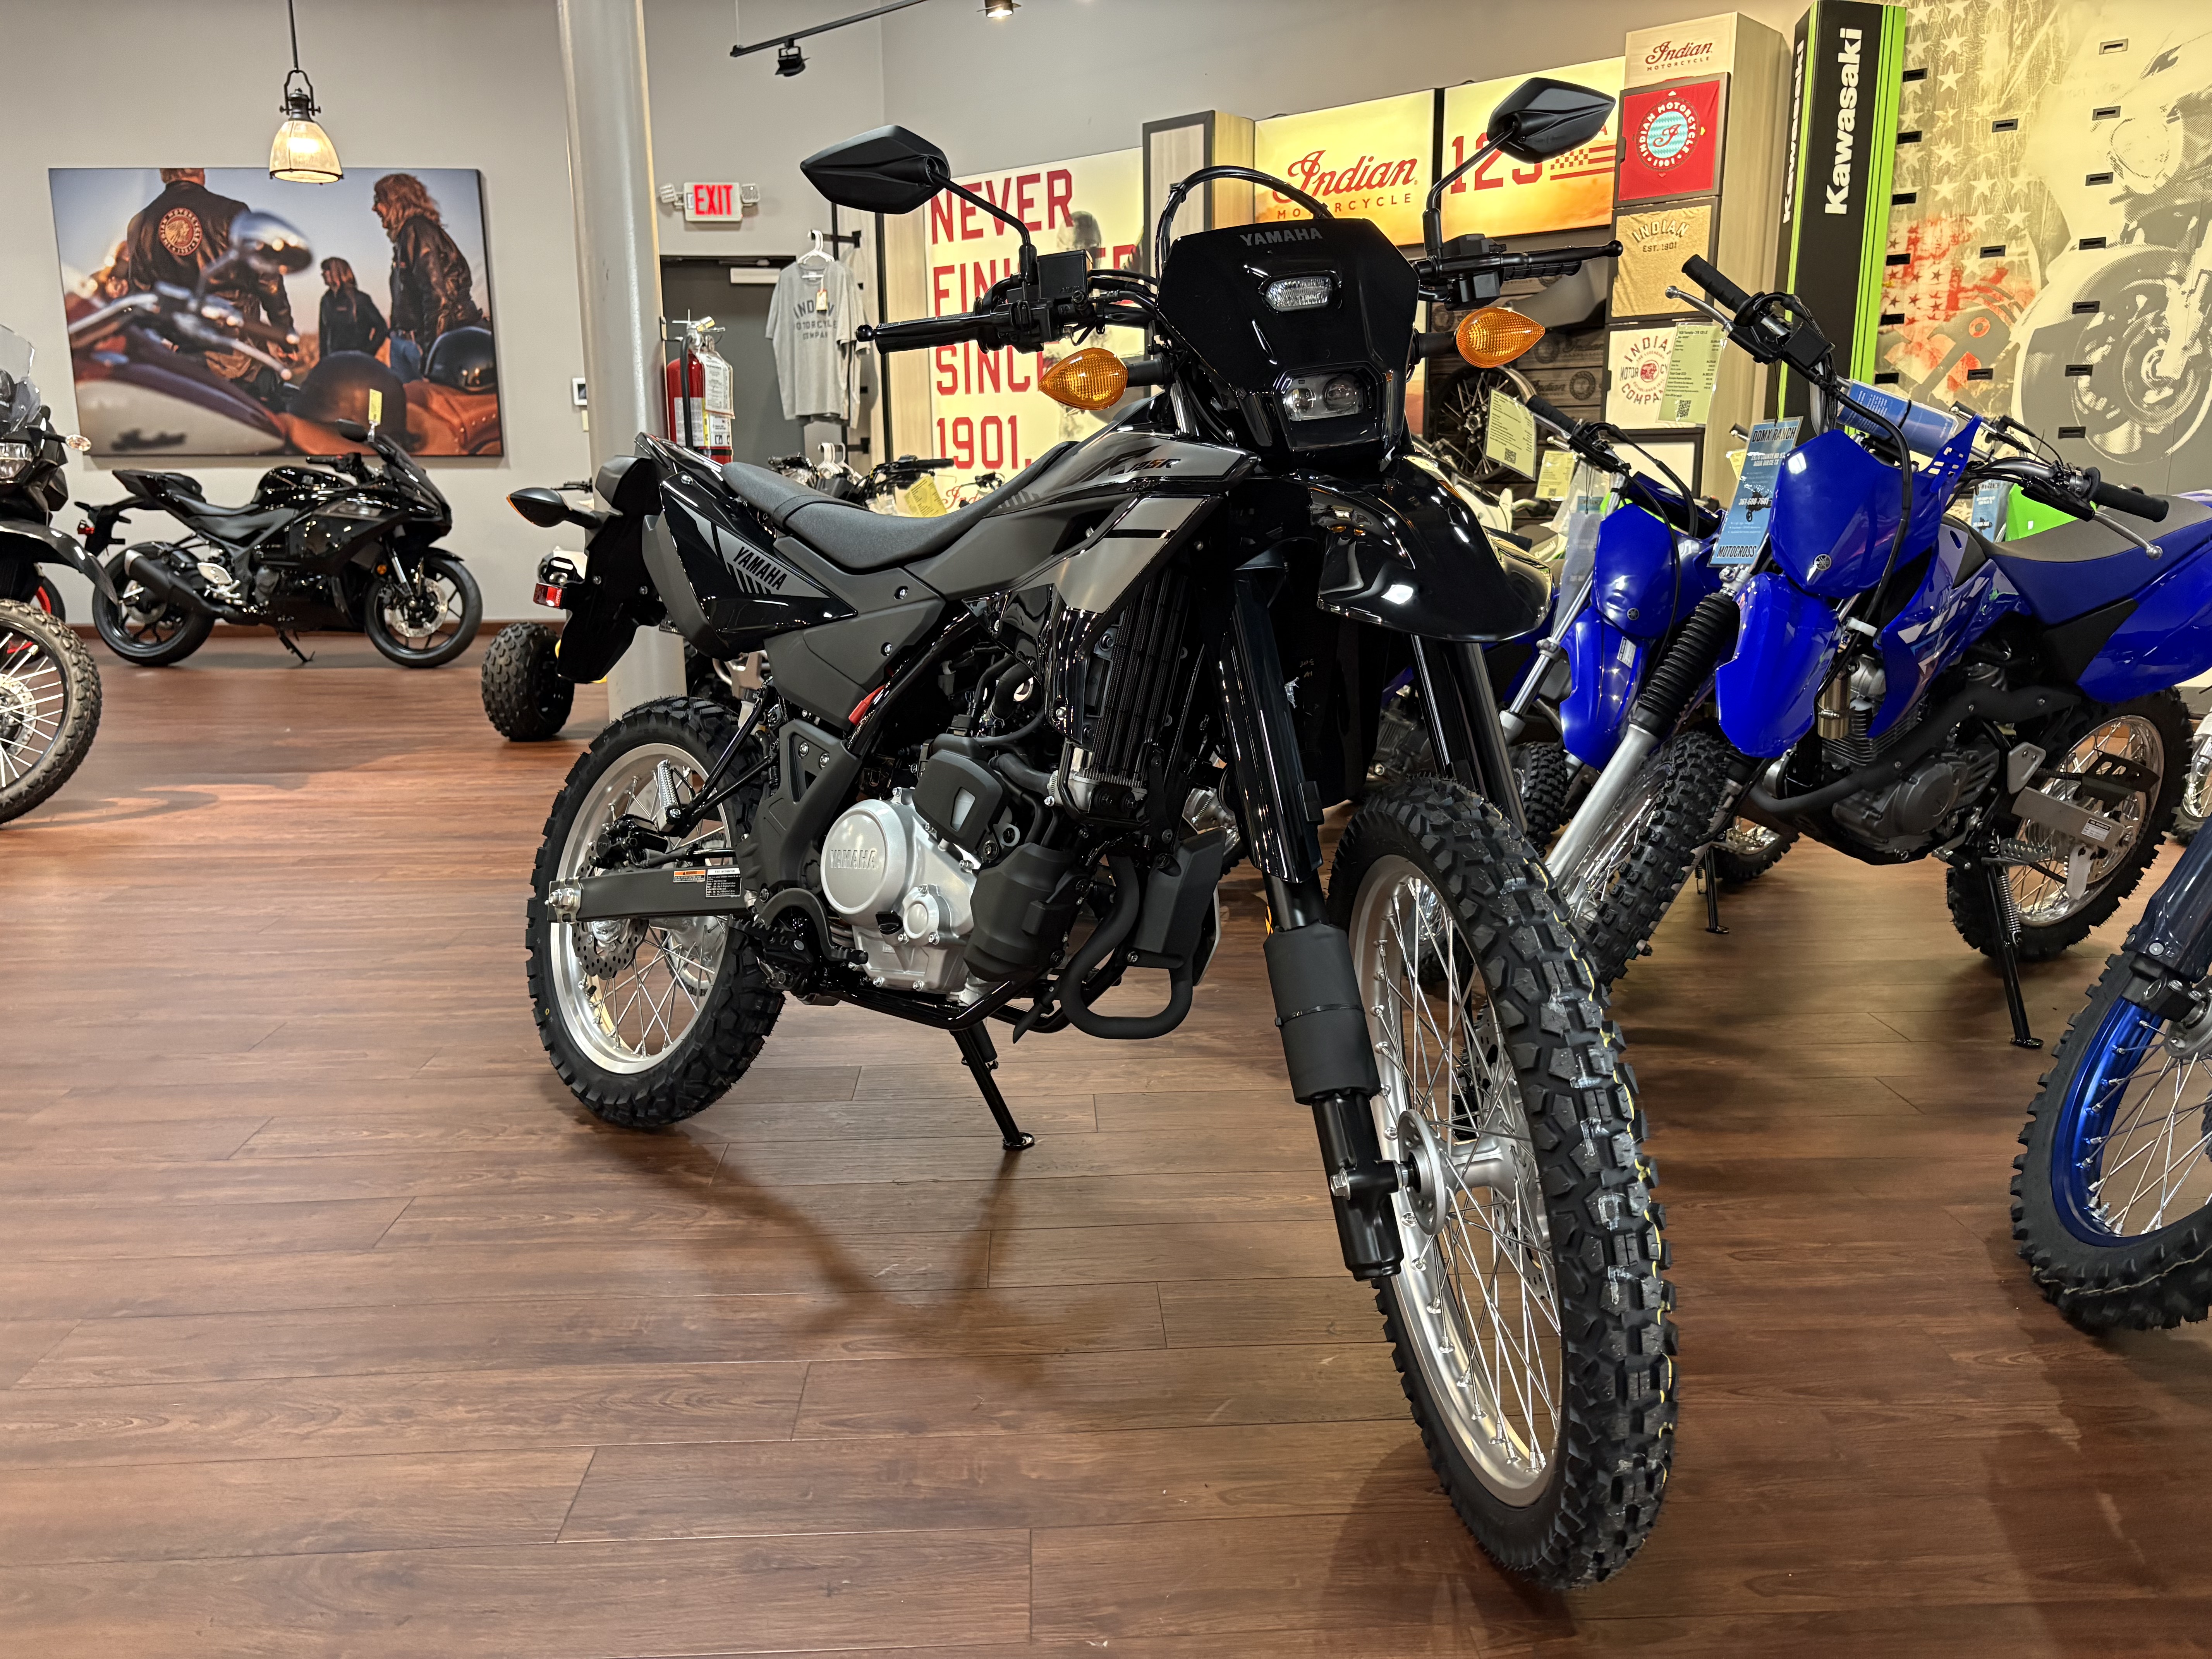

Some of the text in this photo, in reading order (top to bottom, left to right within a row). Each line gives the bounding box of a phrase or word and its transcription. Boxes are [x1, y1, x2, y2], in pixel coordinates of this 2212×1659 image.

[1645, 41, 1713, 65] Indian
[1647, 56, 1709, 71] MOTORCYCLE
[1639, 101, 1697, 158] INDIAN MOTORCYCLE
[1783, 40, 1804, 223] Kawasaki
[1825, 28, 1862, 214] Kawasaki
[1653, 158, 1676, 167] 1901
[1273, 150, 1416, 204] Indian
[694, 184, 733, 216] EXIT
[931, 168, 1073, 245] NEVER
[1277, 193, 1411, 219] MORCYCLE
[1240, 227, 1323, 247] YAMAHA
[1632, 219, 1690, 244] INDIAN
[1642, 241, 1677, 252] EST. 1901
[1620, 366, 1639, 381] MOTOR
[936, 415, 1032, 470] 1901.
[1772, 426, 1797, 441] RANCH
[1717, 545, 1757, 558] MOTOCROSS
[732, 546, 788, 591] YAMAHA
[830, 849, 876, 870] YAMAHA
